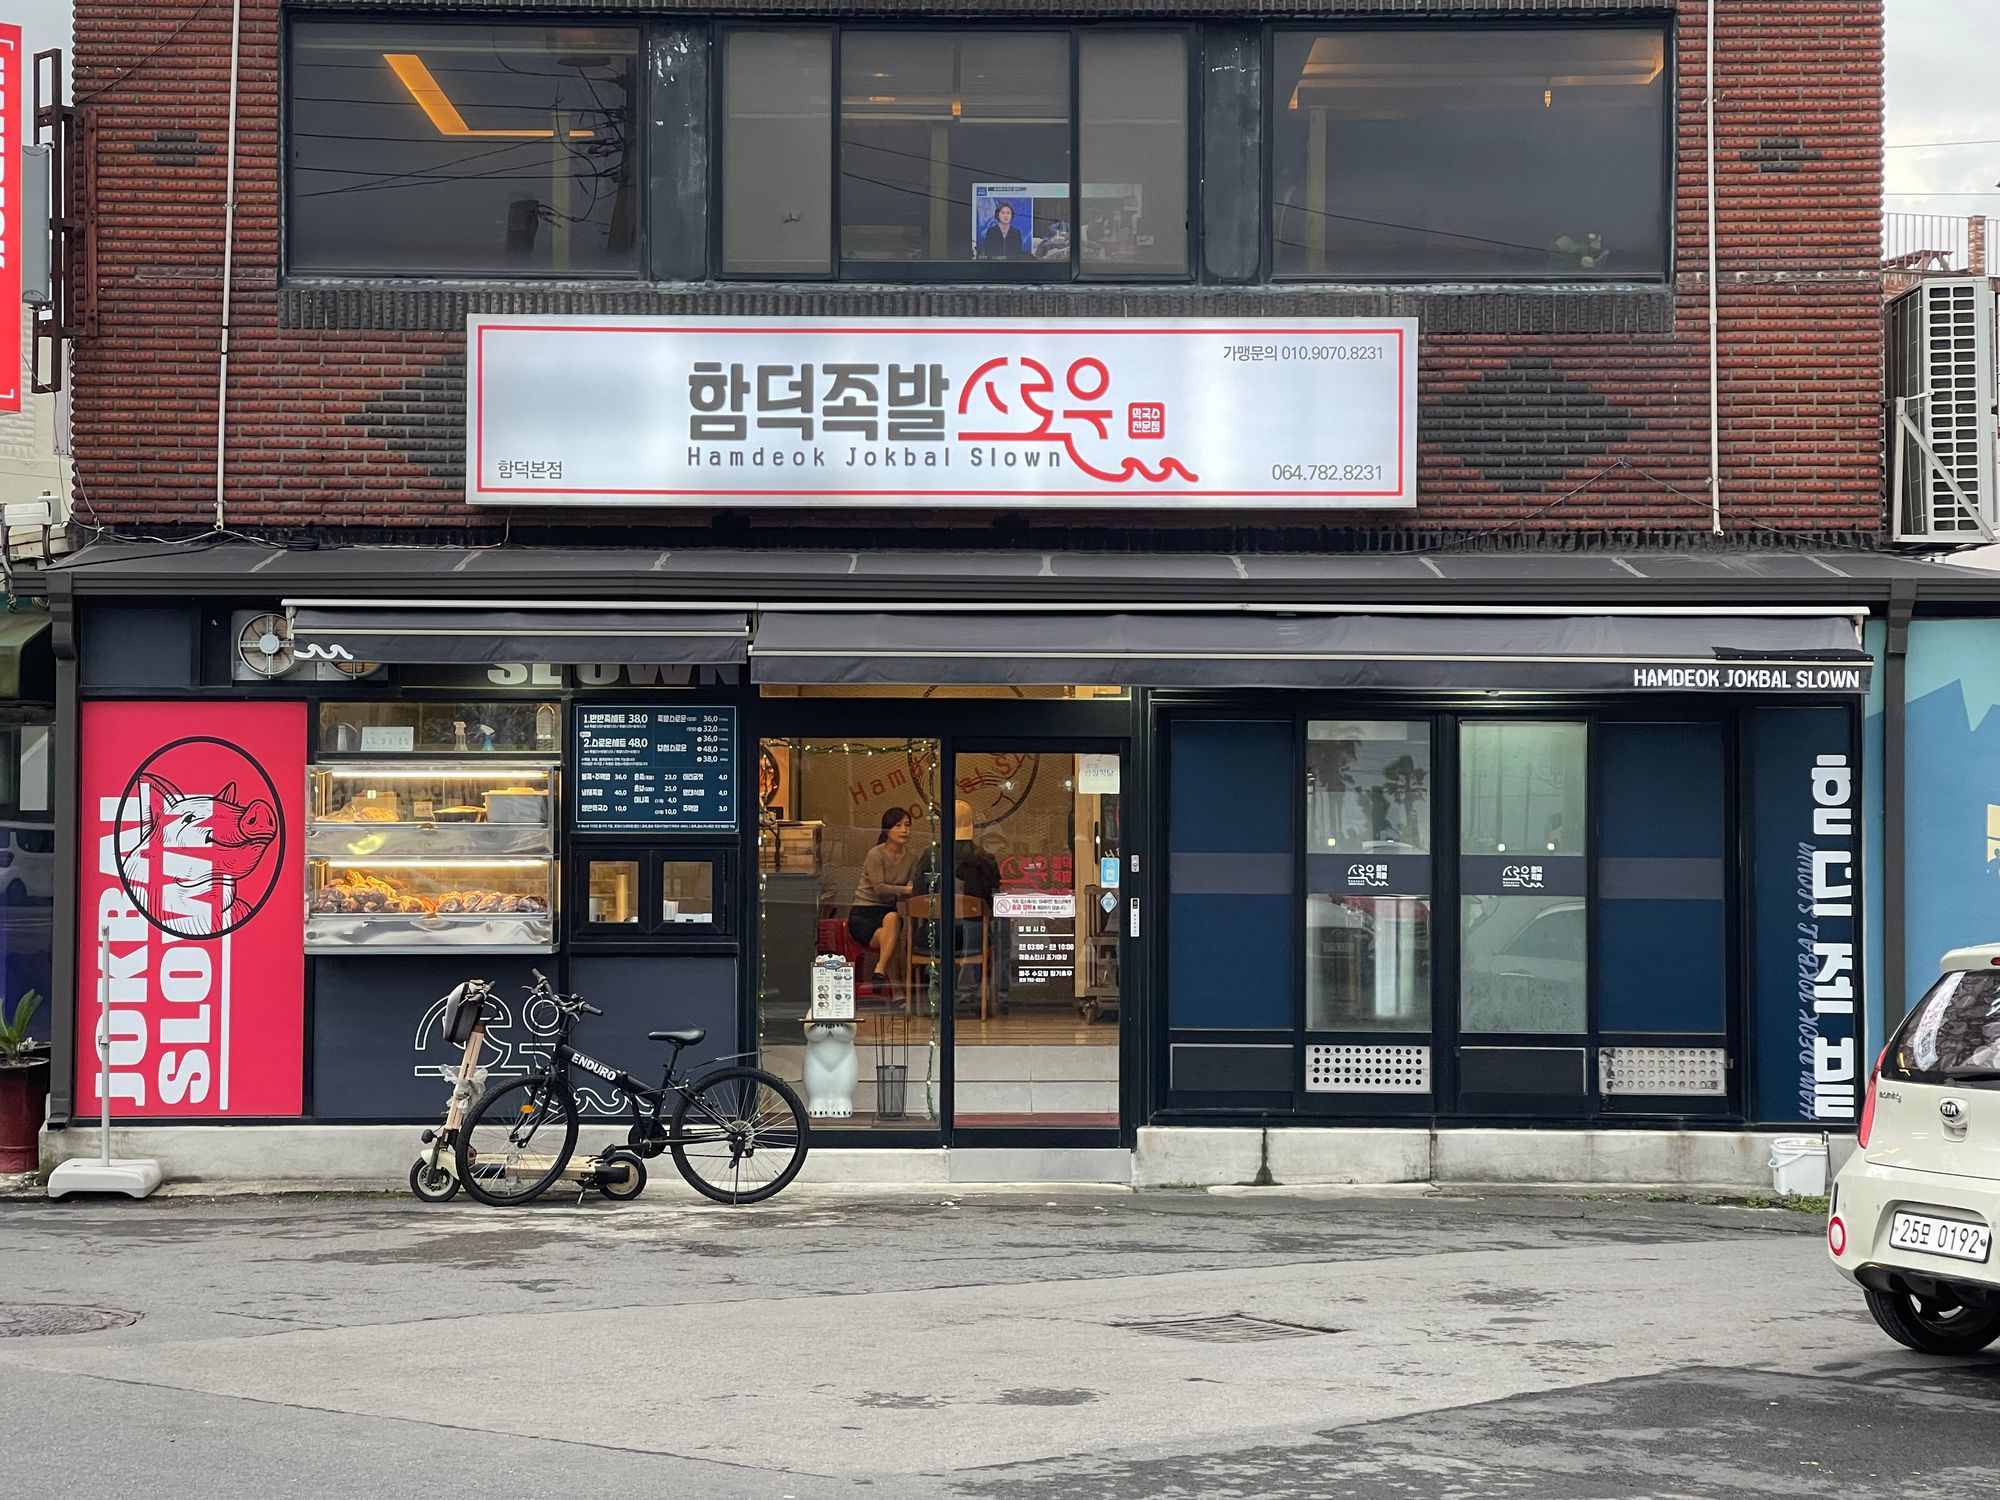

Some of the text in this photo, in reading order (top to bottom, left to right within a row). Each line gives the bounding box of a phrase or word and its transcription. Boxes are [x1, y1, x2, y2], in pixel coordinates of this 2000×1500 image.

[1223, 345, 1384, 362] 가맹문의 010.9070.8231
[689, 362, 950, 441] 함덕족발
[1132, 407, 1160, 420] 막국수
[1132, 421, 1160, 433] 전문점
[687, 447, 1062, 467] Hamdeok Jokbal Slown
[498, 460, 563, 480] 함덕본점
[1272, 464, 1383, 482] 064.782.8231
[1633, 668, 1860, 689] HAMDEOK JOKBAL SLOWN
[628, 714, 648, 725] 38,0
[628, 738, 648, 749] 48,0
[95, 782, 151, 1107] JOKBAL
[158, 793, 213, 1104] SLOWN
[571, 1052, 617, 1081] ENDURO
[1798, 1070, 1821, 1120] HAM
[1941, 1103, 1958, 1116] KIA
[1900, 1219, 1980, 1255] 25모 0192
